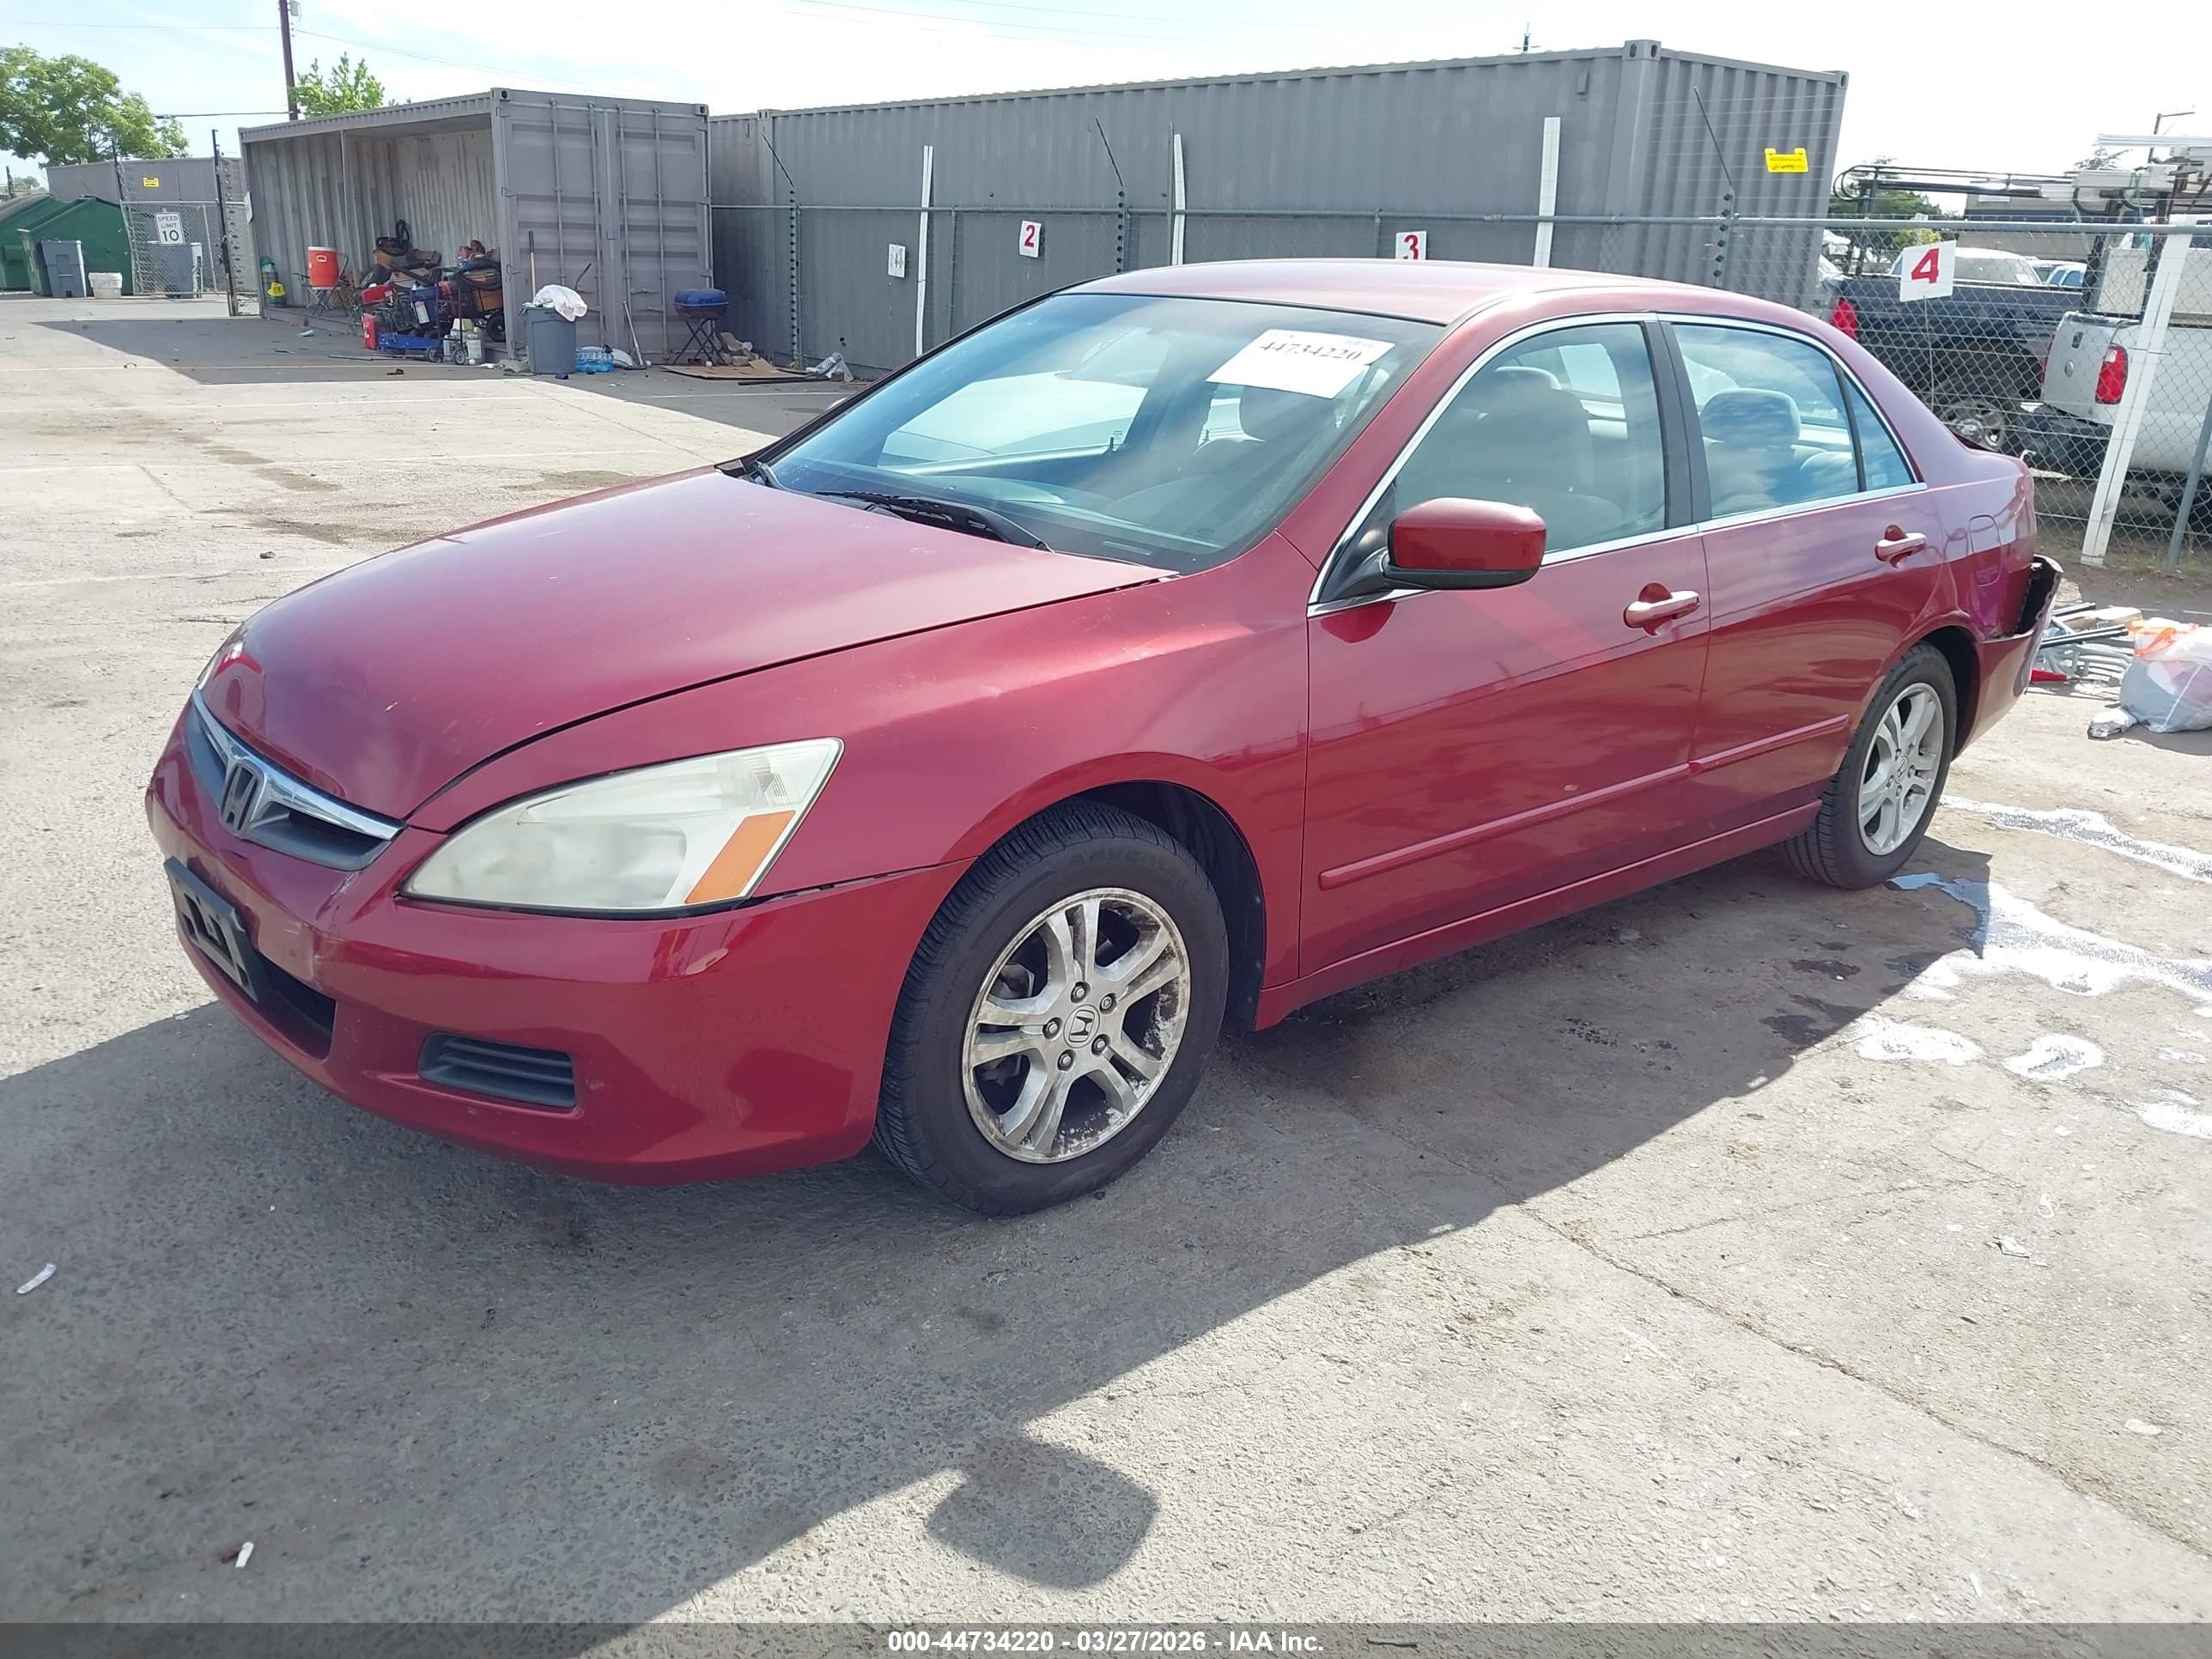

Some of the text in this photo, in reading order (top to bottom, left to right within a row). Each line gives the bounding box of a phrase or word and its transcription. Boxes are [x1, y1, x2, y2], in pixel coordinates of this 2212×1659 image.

[162, 230, 179, 241] 10
[1024, 224, 1036, 247] 2
[1402, 234, 1419, 260] 3
[1911, 247, 1940, 283] 4
[1258, 341, 1362, 362] 44734220
